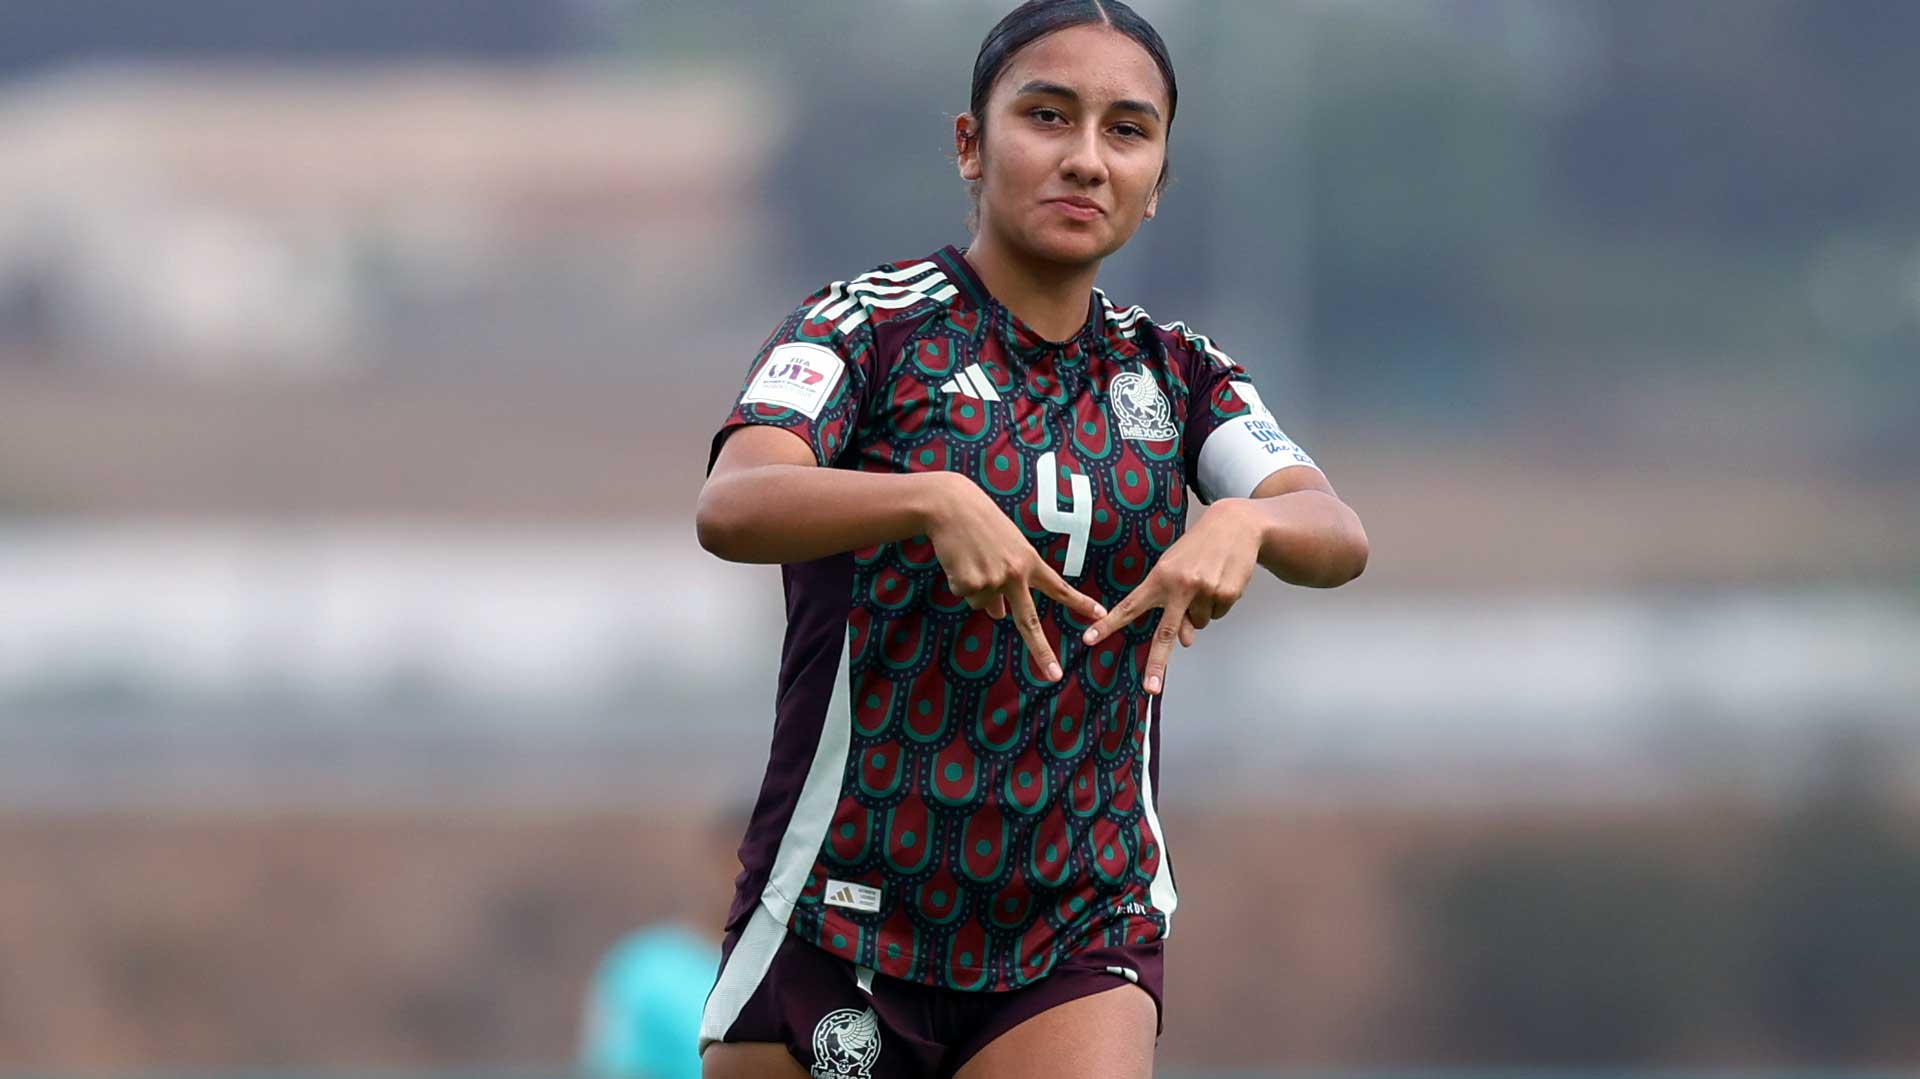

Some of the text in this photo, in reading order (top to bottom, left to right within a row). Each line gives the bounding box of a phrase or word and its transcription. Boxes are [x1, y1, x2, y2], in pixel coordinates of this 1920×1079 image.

[790, 358, 810, 367] FIFA
[768, 364, 824, 385] U17
[1037, 452, 1092, 577] 4
